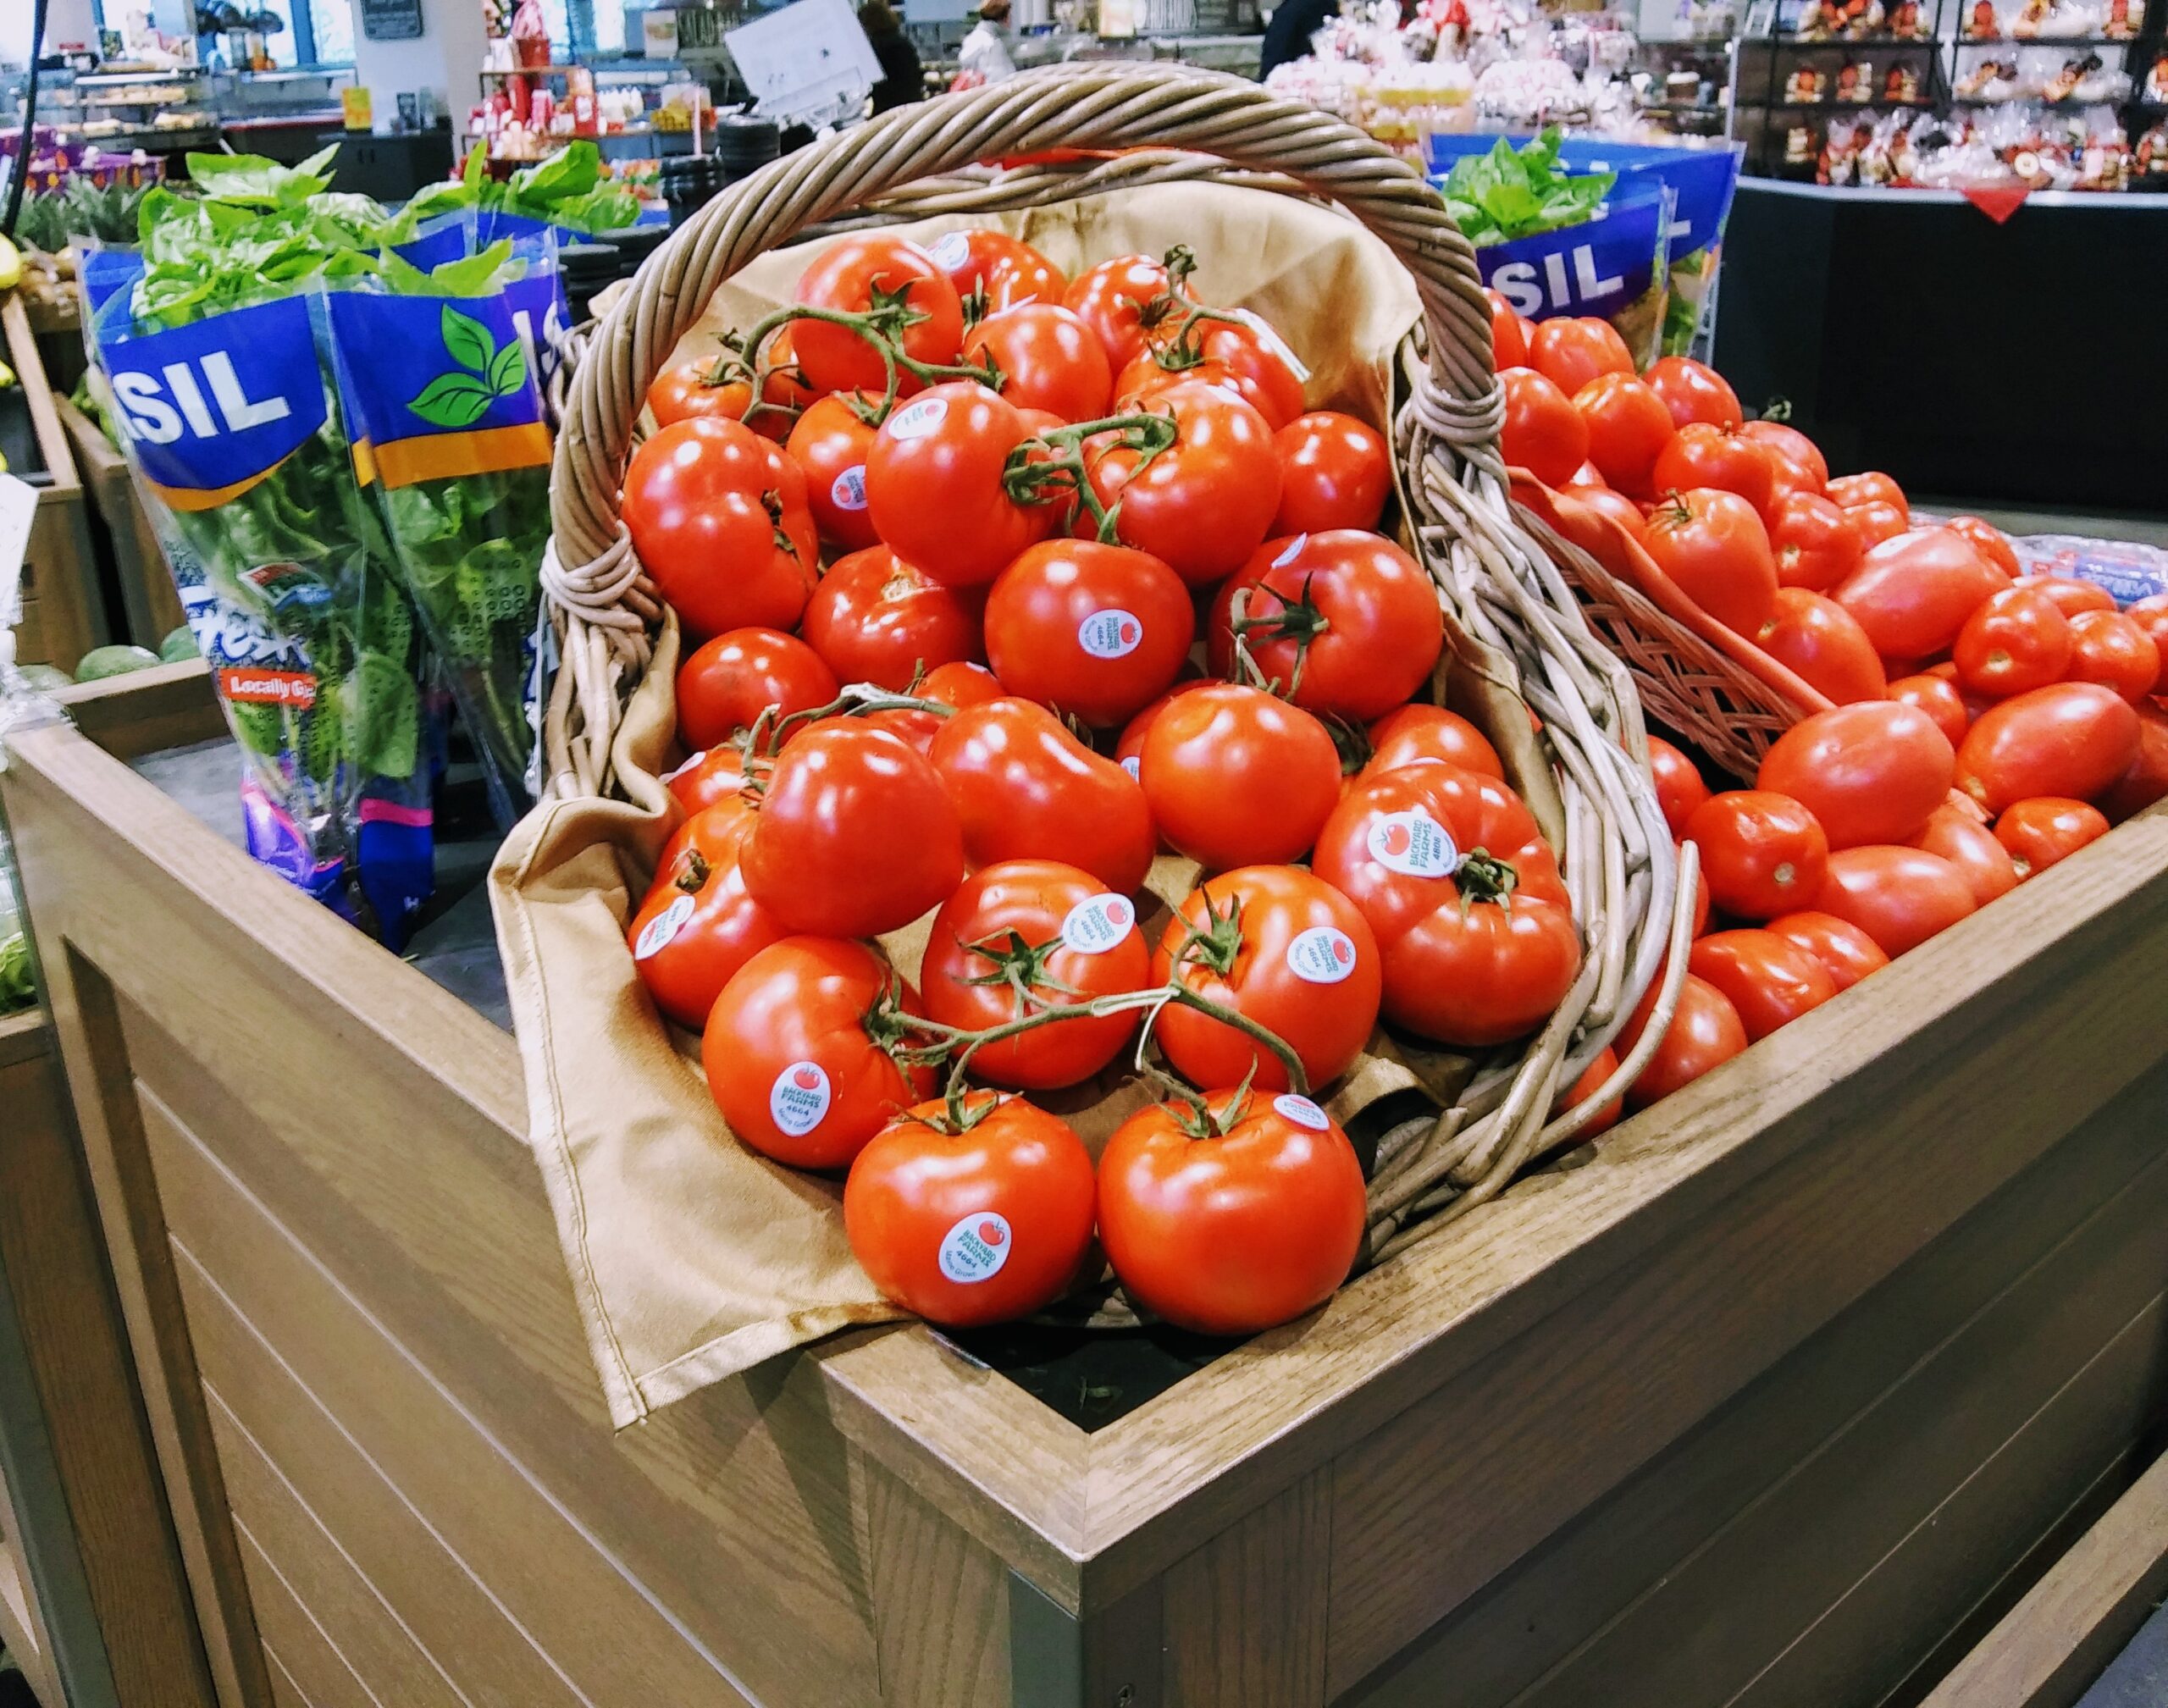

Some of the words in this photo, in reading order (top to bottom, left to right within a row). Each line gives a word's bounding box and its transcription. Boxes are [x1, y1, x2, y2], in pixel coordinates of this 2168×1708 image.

[111, 350, 291, 445] SIL
[230, 676, 290, 699] Locally
[1409, 820, 1423, 865] BACKYARD
[1419, 822, 1432, 868] FARMS
[1433, 837, 1441, 860] 4808
[781, 1092, 820, 1108] FARMS
[956, 1250, 978, 1269] 4664
[957, 1235, 992, 1269] FARMS
[963, 1229, 996, 1261] BACKYARD
